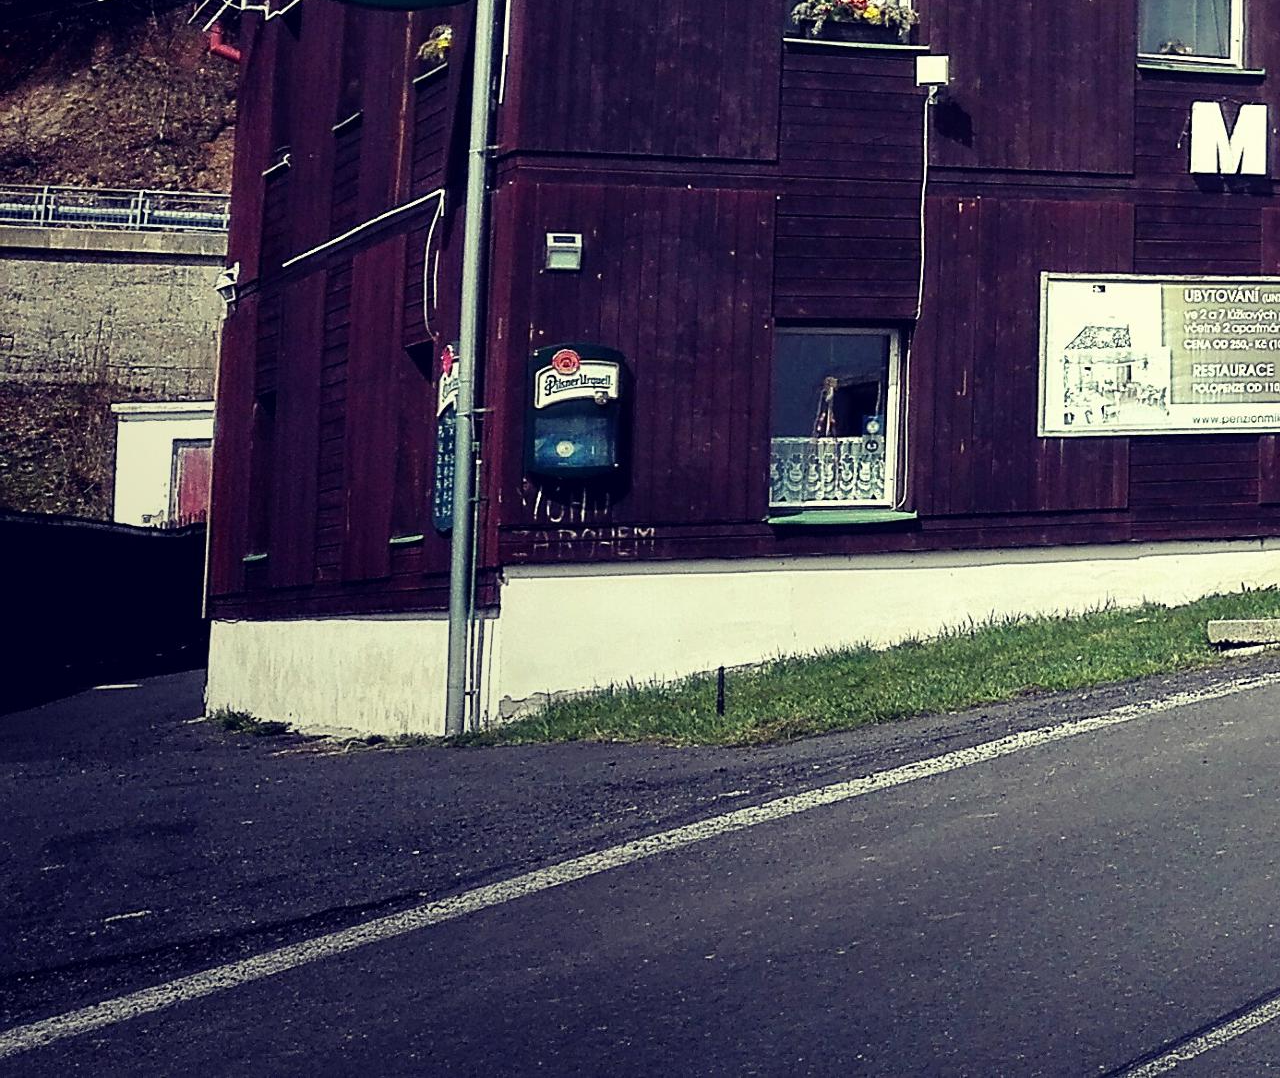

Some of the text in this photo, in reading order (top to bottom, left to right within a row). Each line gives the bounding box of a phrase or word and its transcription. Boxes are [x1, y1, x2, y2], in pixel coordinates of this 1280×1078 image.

[1183, 286, 1259, 303] UBYTOVÁNÍ
[1183, 310, 1199, 320] ve
[1199, 308, 1207, 320] 2
[1208, 311, 1217, 320] a
[1218, 308, 1226, 320] 7
[1183, 322, 1221, 333] včetně
[1222, 322, 1230, 333] 2
[1183, 339, 1211, 350] CENA
[1212, 339, 1229, 350] OD
[1254, 338, 1267, 350] Kč
[1192, 363, 1275, 378] RESTAURACE
[544, 373, 611, 396] Pilsner Urquell
[1246, 382, 1262, 393] OD
